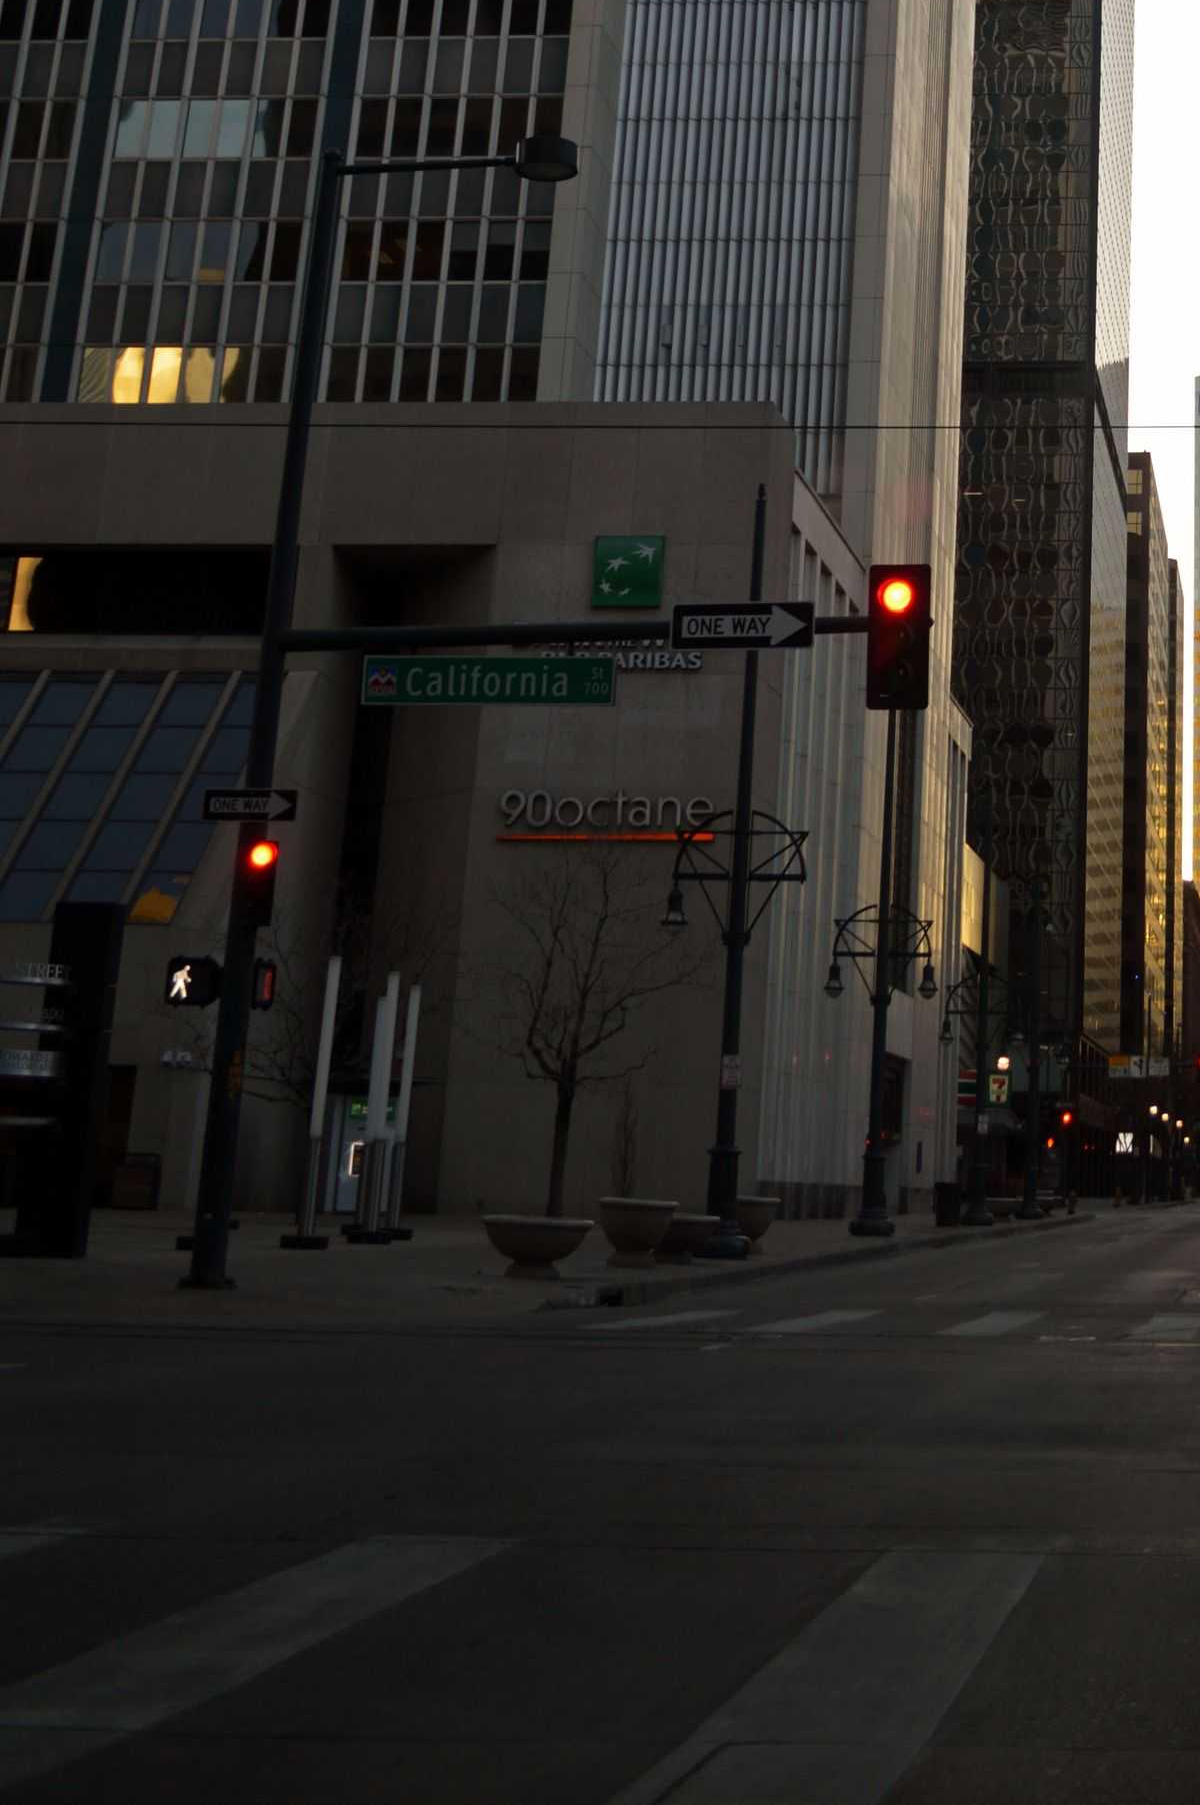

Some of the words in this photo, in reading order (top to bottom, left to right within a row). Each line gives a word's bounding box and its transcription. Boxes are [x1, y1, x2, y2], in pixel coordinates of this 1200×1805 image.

[687, 617, 724, 635] ONE
[732, 616, 771, 634] WAY
[405, 664, 569, 697] California
[592, 666, 604, 681] St
[584, 682, 608, 695] 700
[215, 799, 240, 811] ONE
[243, 797, 268, 811] WAY
[501, 788, 714, 827] 90octane
